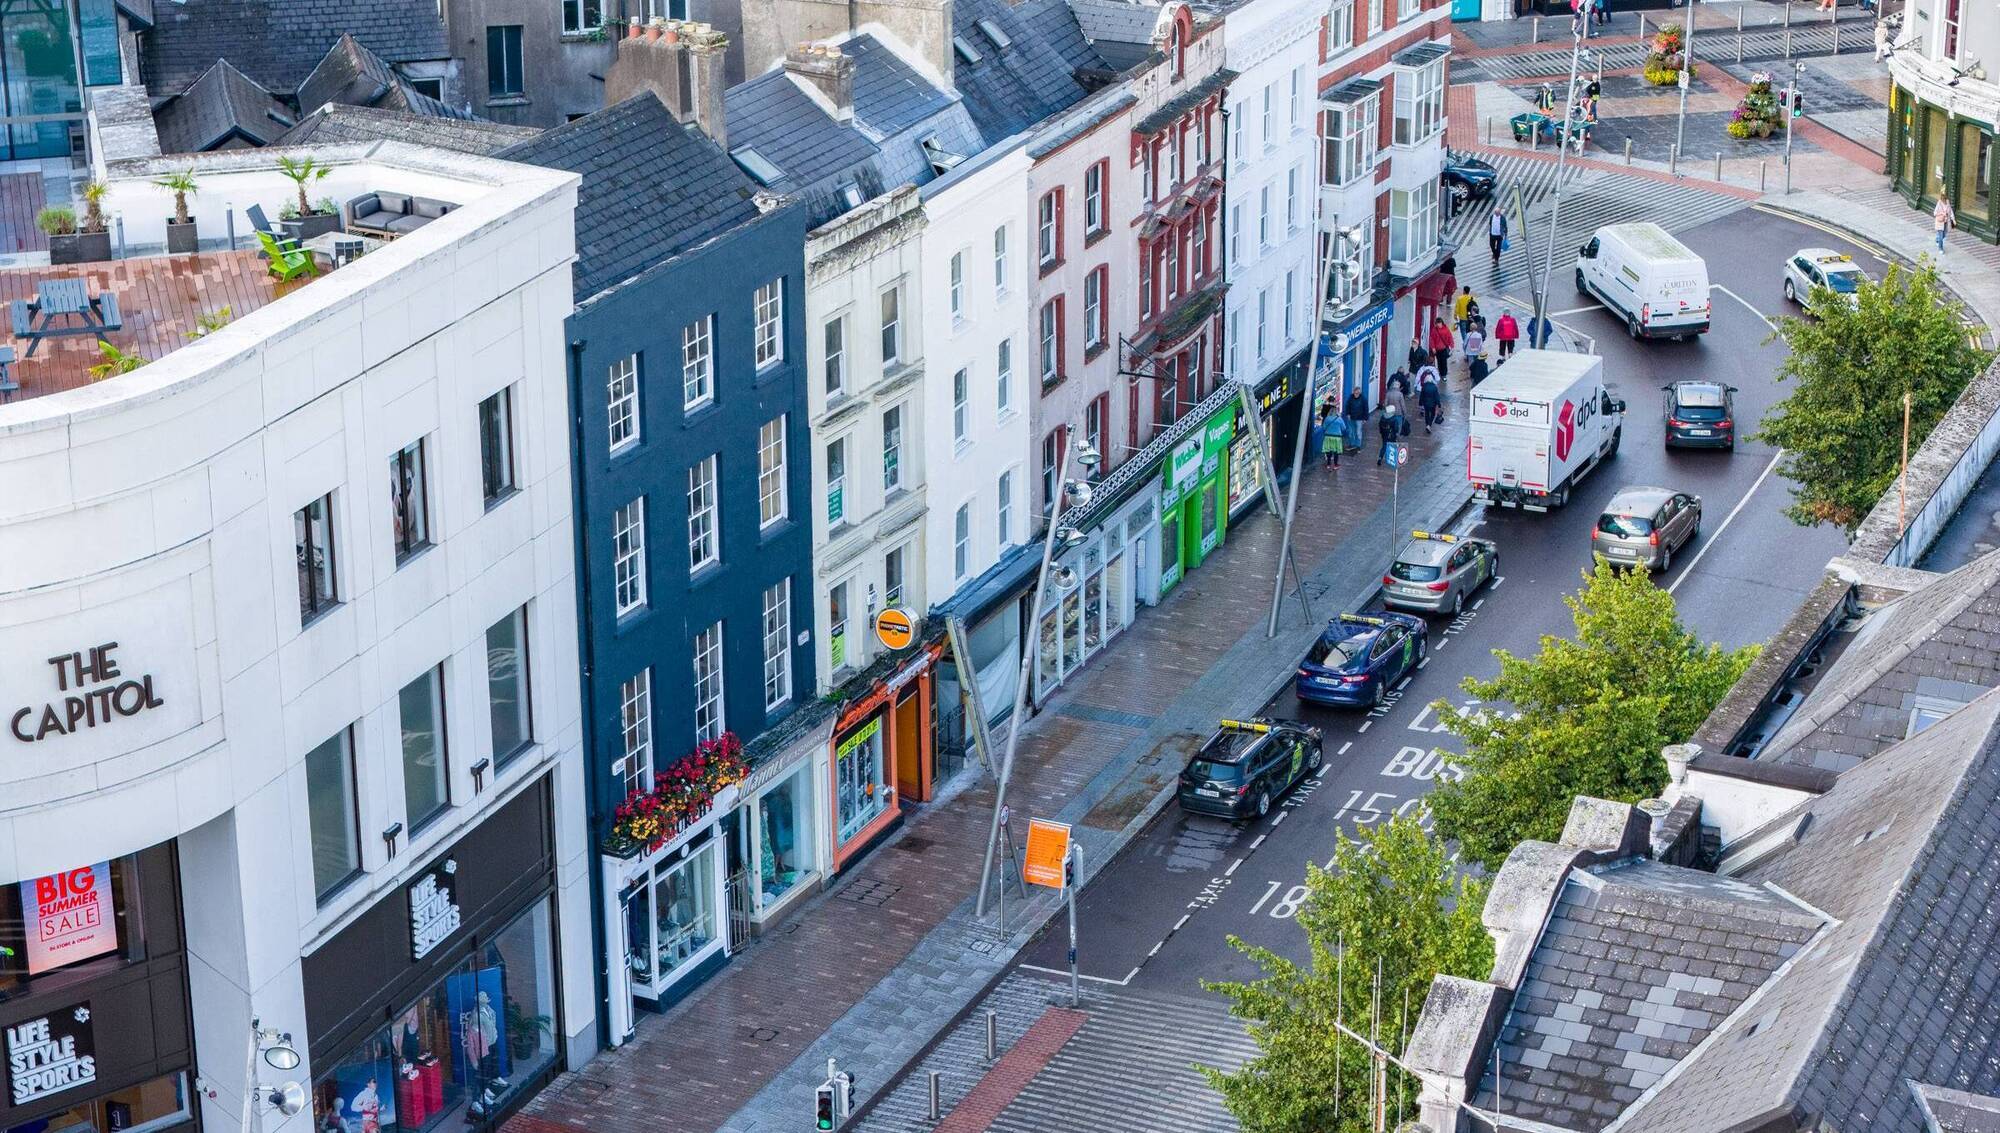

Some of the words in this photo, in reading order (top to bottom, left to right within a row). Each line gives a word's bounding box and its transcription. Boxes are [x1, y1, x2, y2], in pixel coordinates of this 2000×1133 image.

[1510, 407, 1529, 419] dpd
[1577, 387, 1598, 430] dpd
[1443, 611, 1477, 635] TAXIS
[48, 641, 121, 691] THE
[11, 674, 164, 742] CAPITOL
[1366, 690, 1403, 717] TAXIS
[1380, 746, 1465, 783] BUS
[1281, 778, 1322, 807] TAXIS
[36, 866, 95, 905] BIG
[411, 874, 437, 907] LIFE
[1187, 877, 1231, 908] TAXIS
[39, 890, 98, 917] SUMMER
[45, 907, 96, 935] SALE
[413, 888, 450, 929] STYLE
[414, 905, 460, 952] SPORTS
[7, 1017, 50, 1050] LIFE
[10, 1035, 76, 1074] STYLE
[12, 1055, 96, 1099] SPORTS
